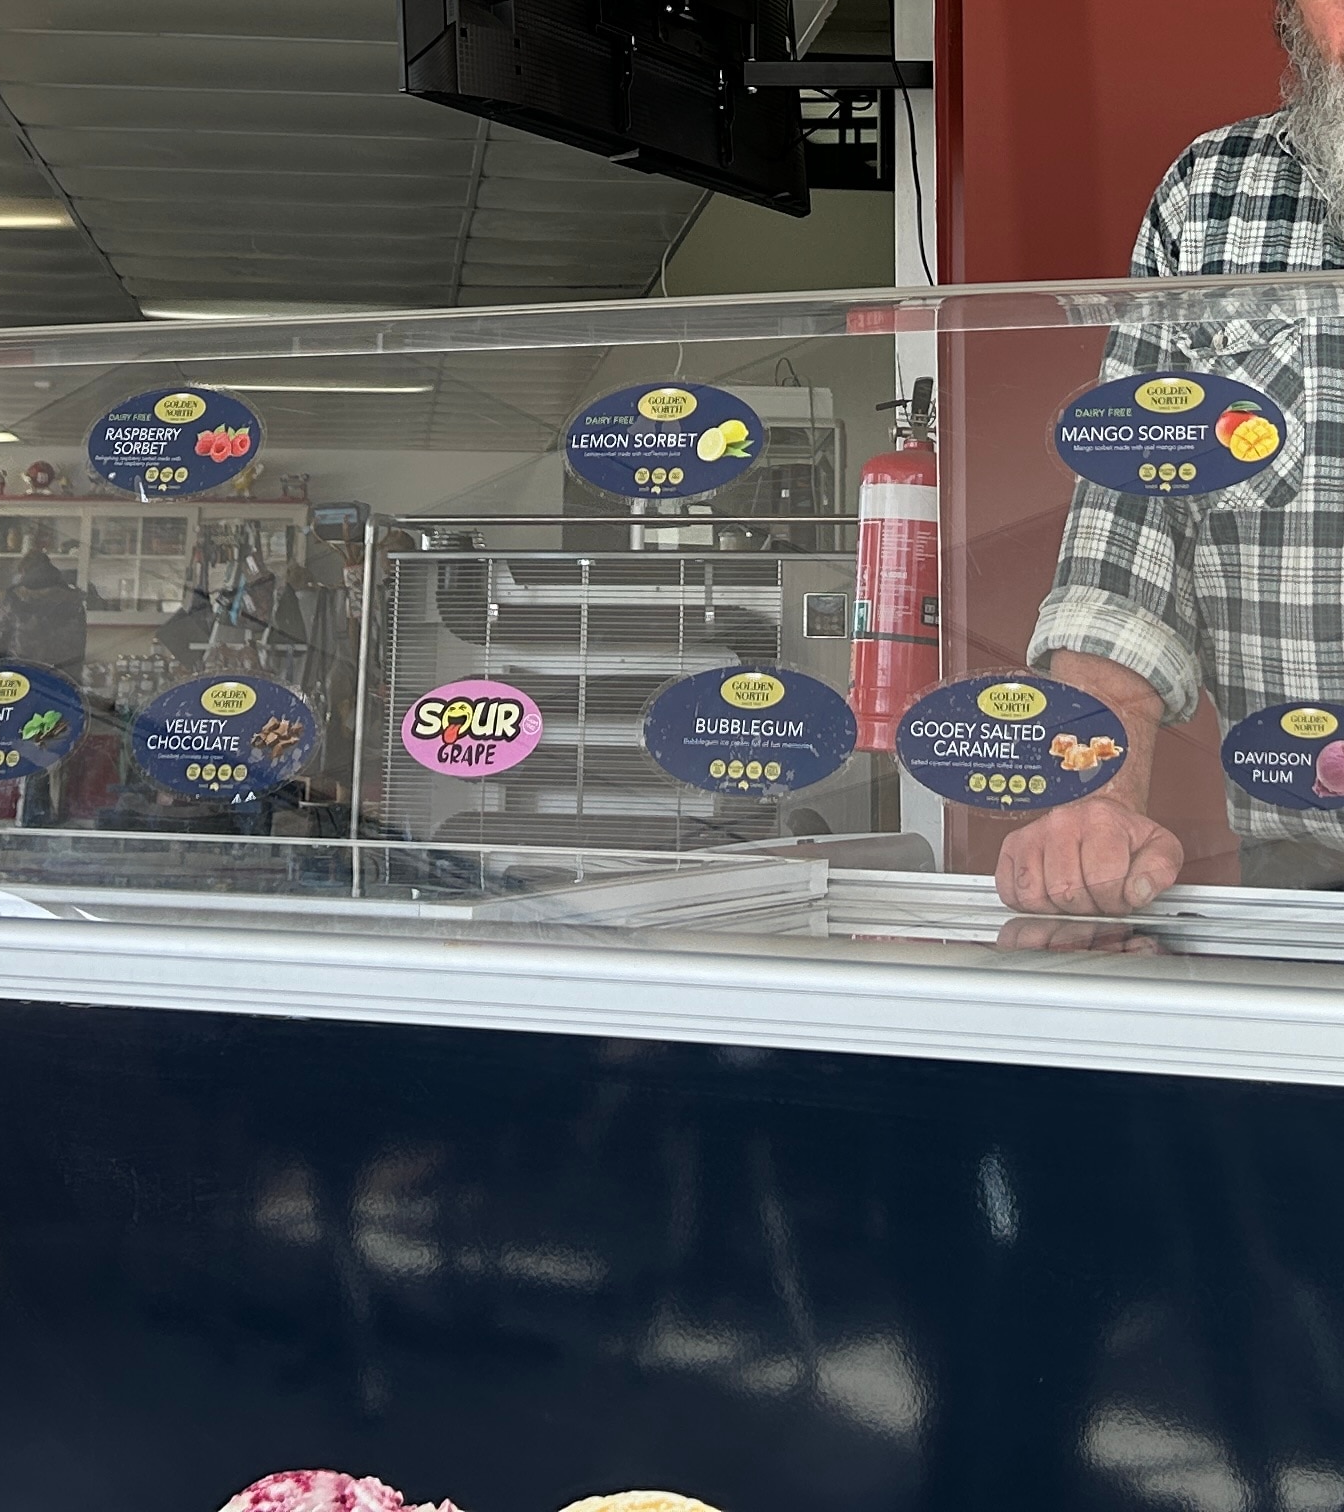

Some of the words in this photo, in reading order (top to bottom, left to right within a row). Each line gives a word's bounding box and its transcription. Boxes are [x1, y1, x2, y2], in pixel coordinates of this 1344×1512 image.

[1147, 386, 1192, 395] GOLDEN
[163, 400, 198, 409] GOLDEN
[648, 396, 687, 405] GOLDEN
[1151, 396, 1188, 405] NORTH
[651, 405, 683, 414] NORTH
[1075, 408, 1105, 418] DAIRY
[1107, 408, 1132, 417] FREE
[585, 416, 612, 425] DAIRY
[613, 416, 635, 425] FREE
[105, 427, 182, 441] RASPBERRY
[1061, 426, 1133, 442] MANGO
[1138, 425, 1209, 441] SORBET
[571, 433, 629, 449] LEMON
[634, 432, 698, 448] SORBET
[113, 442, 167, 455] SORBET
[732, 680, 774, 691] GOLDEN
[210, 690, 247, 699] GOLDEN
[734, 691, 769, 701] NORTH
[989, 692, 1035, 702] GOLDEN
[212, 699, 243, 709] NORTH
[993, 702, 1031, 712] NORTH
[1290, 715, 1328, 723] GOLDEN
[165, 719, 227, 734] VELVETY
[695, 718, 804, 737] BUBBLEGUM
[910, 720, 977, 739] GOOEY
[980, 724, 1046, 741] SALTED
[1293, 723, 1325, 732] NORTH
[147, 735, 240, 752] CHOCOLATE
[933, 740, 1020, 759] CARAMEL
[437, 744, 497, 766] GRAPE
[1234, 751, 1312, 766] DAVIDSON
[1252, 769, 1293, 784] PLUM
